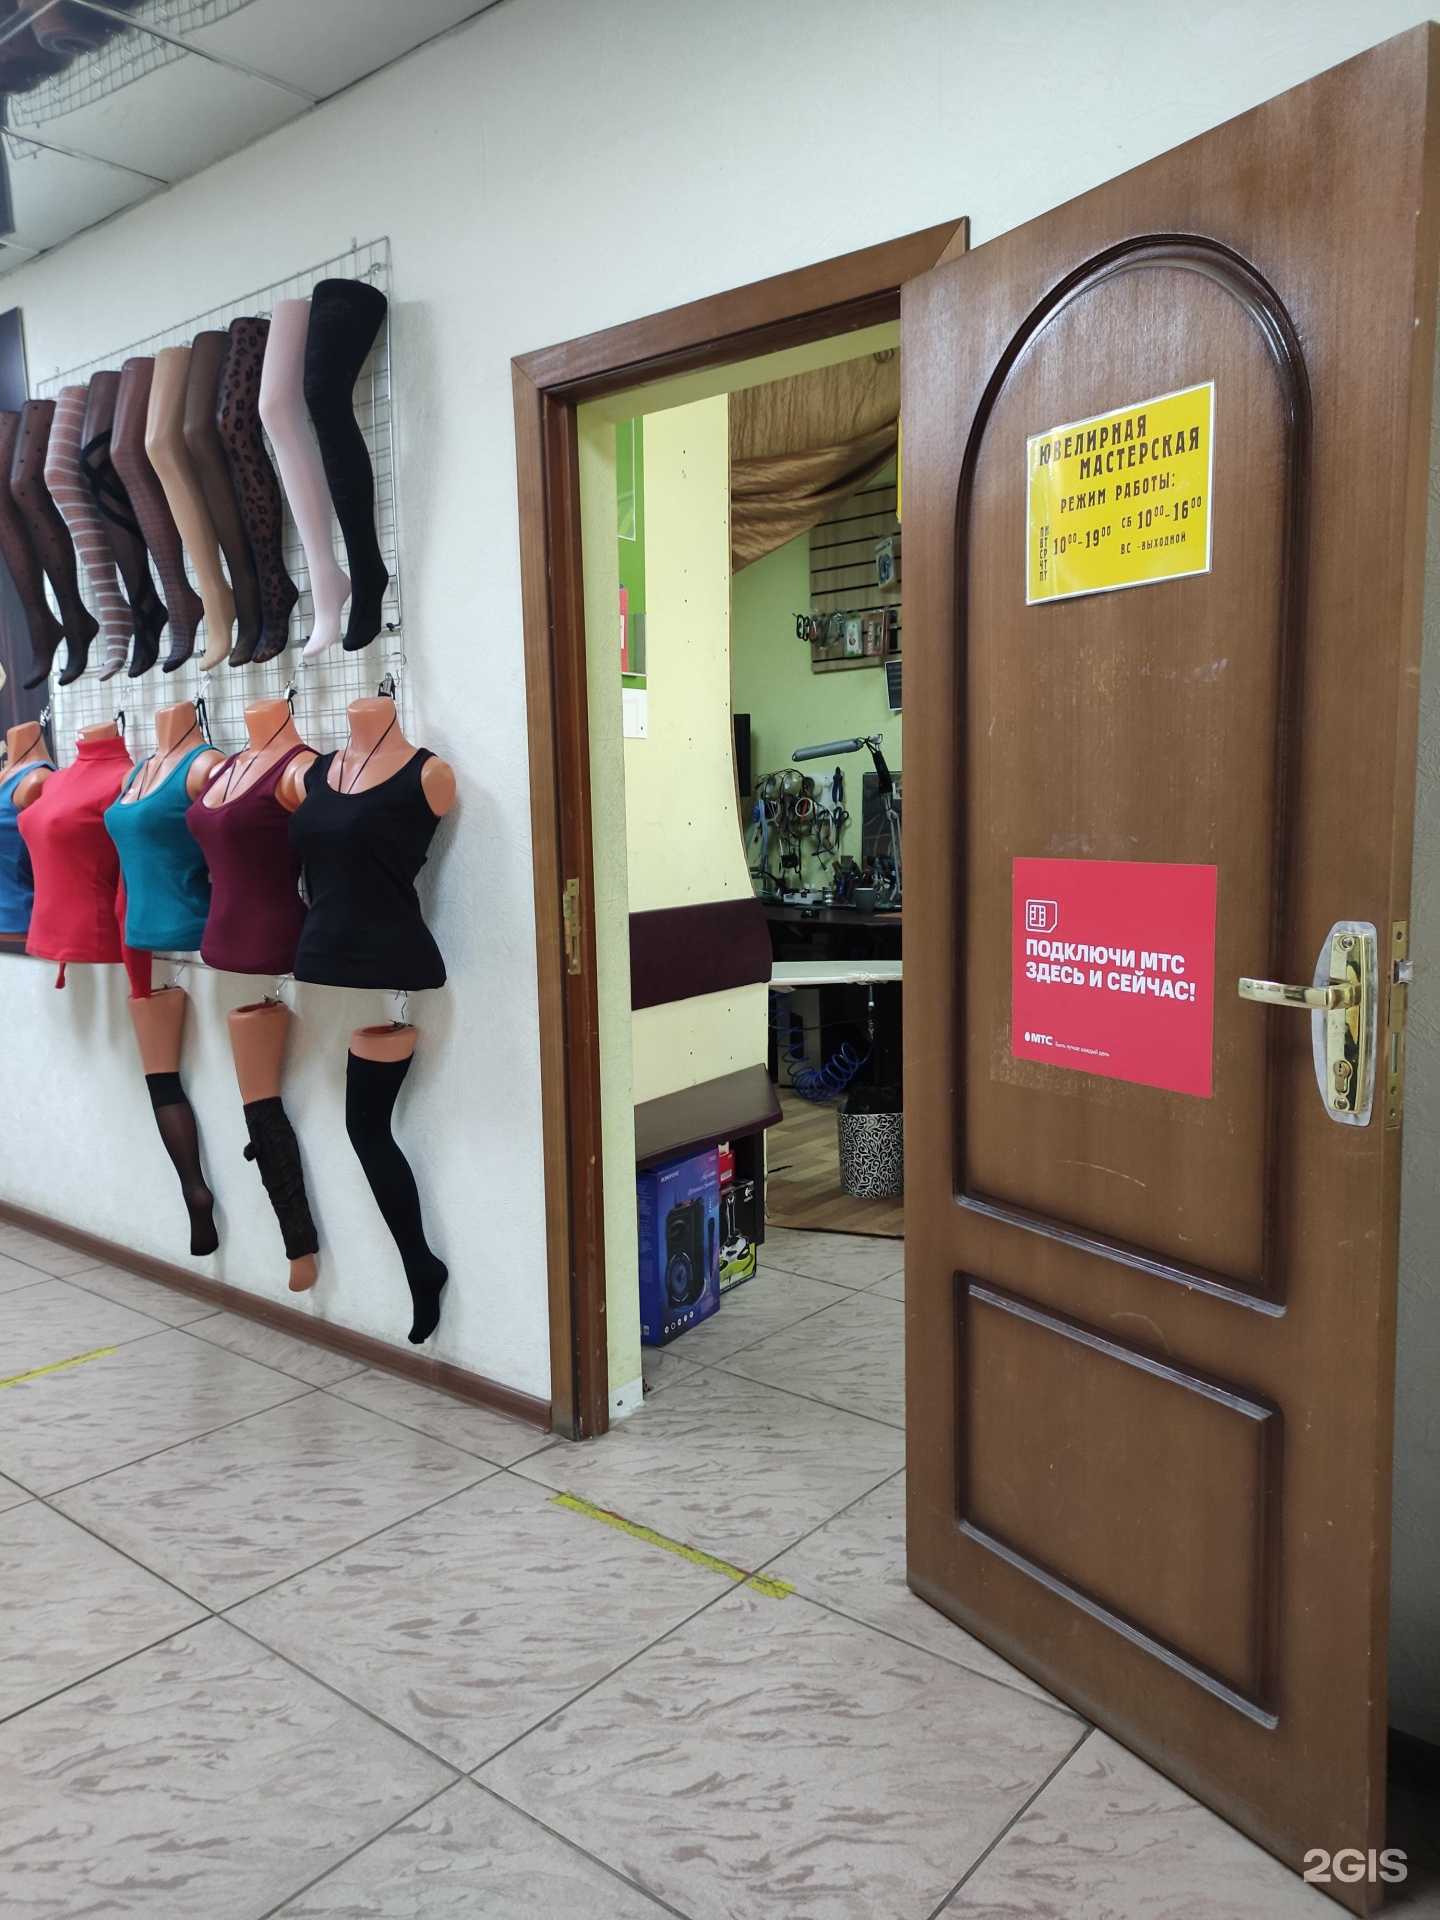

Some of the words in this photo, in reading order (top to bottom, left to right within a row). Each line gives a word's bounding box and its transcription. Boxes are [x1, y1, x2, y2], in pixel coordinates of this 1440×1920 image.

[1039, 414, 1147, 466] ЮВЕЛИРНАЯ
[1079, 426, 1200, 479] МАСТЕРСКАЯ
[1060, 488, 1107, 514] РЕЖИМ
[1115, 472, 1176, 501] РАБОТЫ:
[1121, 516, 1132, 529] СБ
[1120, 542, 1131, 555] ВС
[1025, 938, 1136, 969] ПОДКЛЮЧИ
[1140, 951, 1185, 975] МТС
[1025, 961, 1086, 986] ЗДЕСЬ
[1089, 970, 1103, 988] И
[1107, 971, 1197, 1002] СЕЙЧАС!
[1031, 1032, 1053, 1046] МТС
